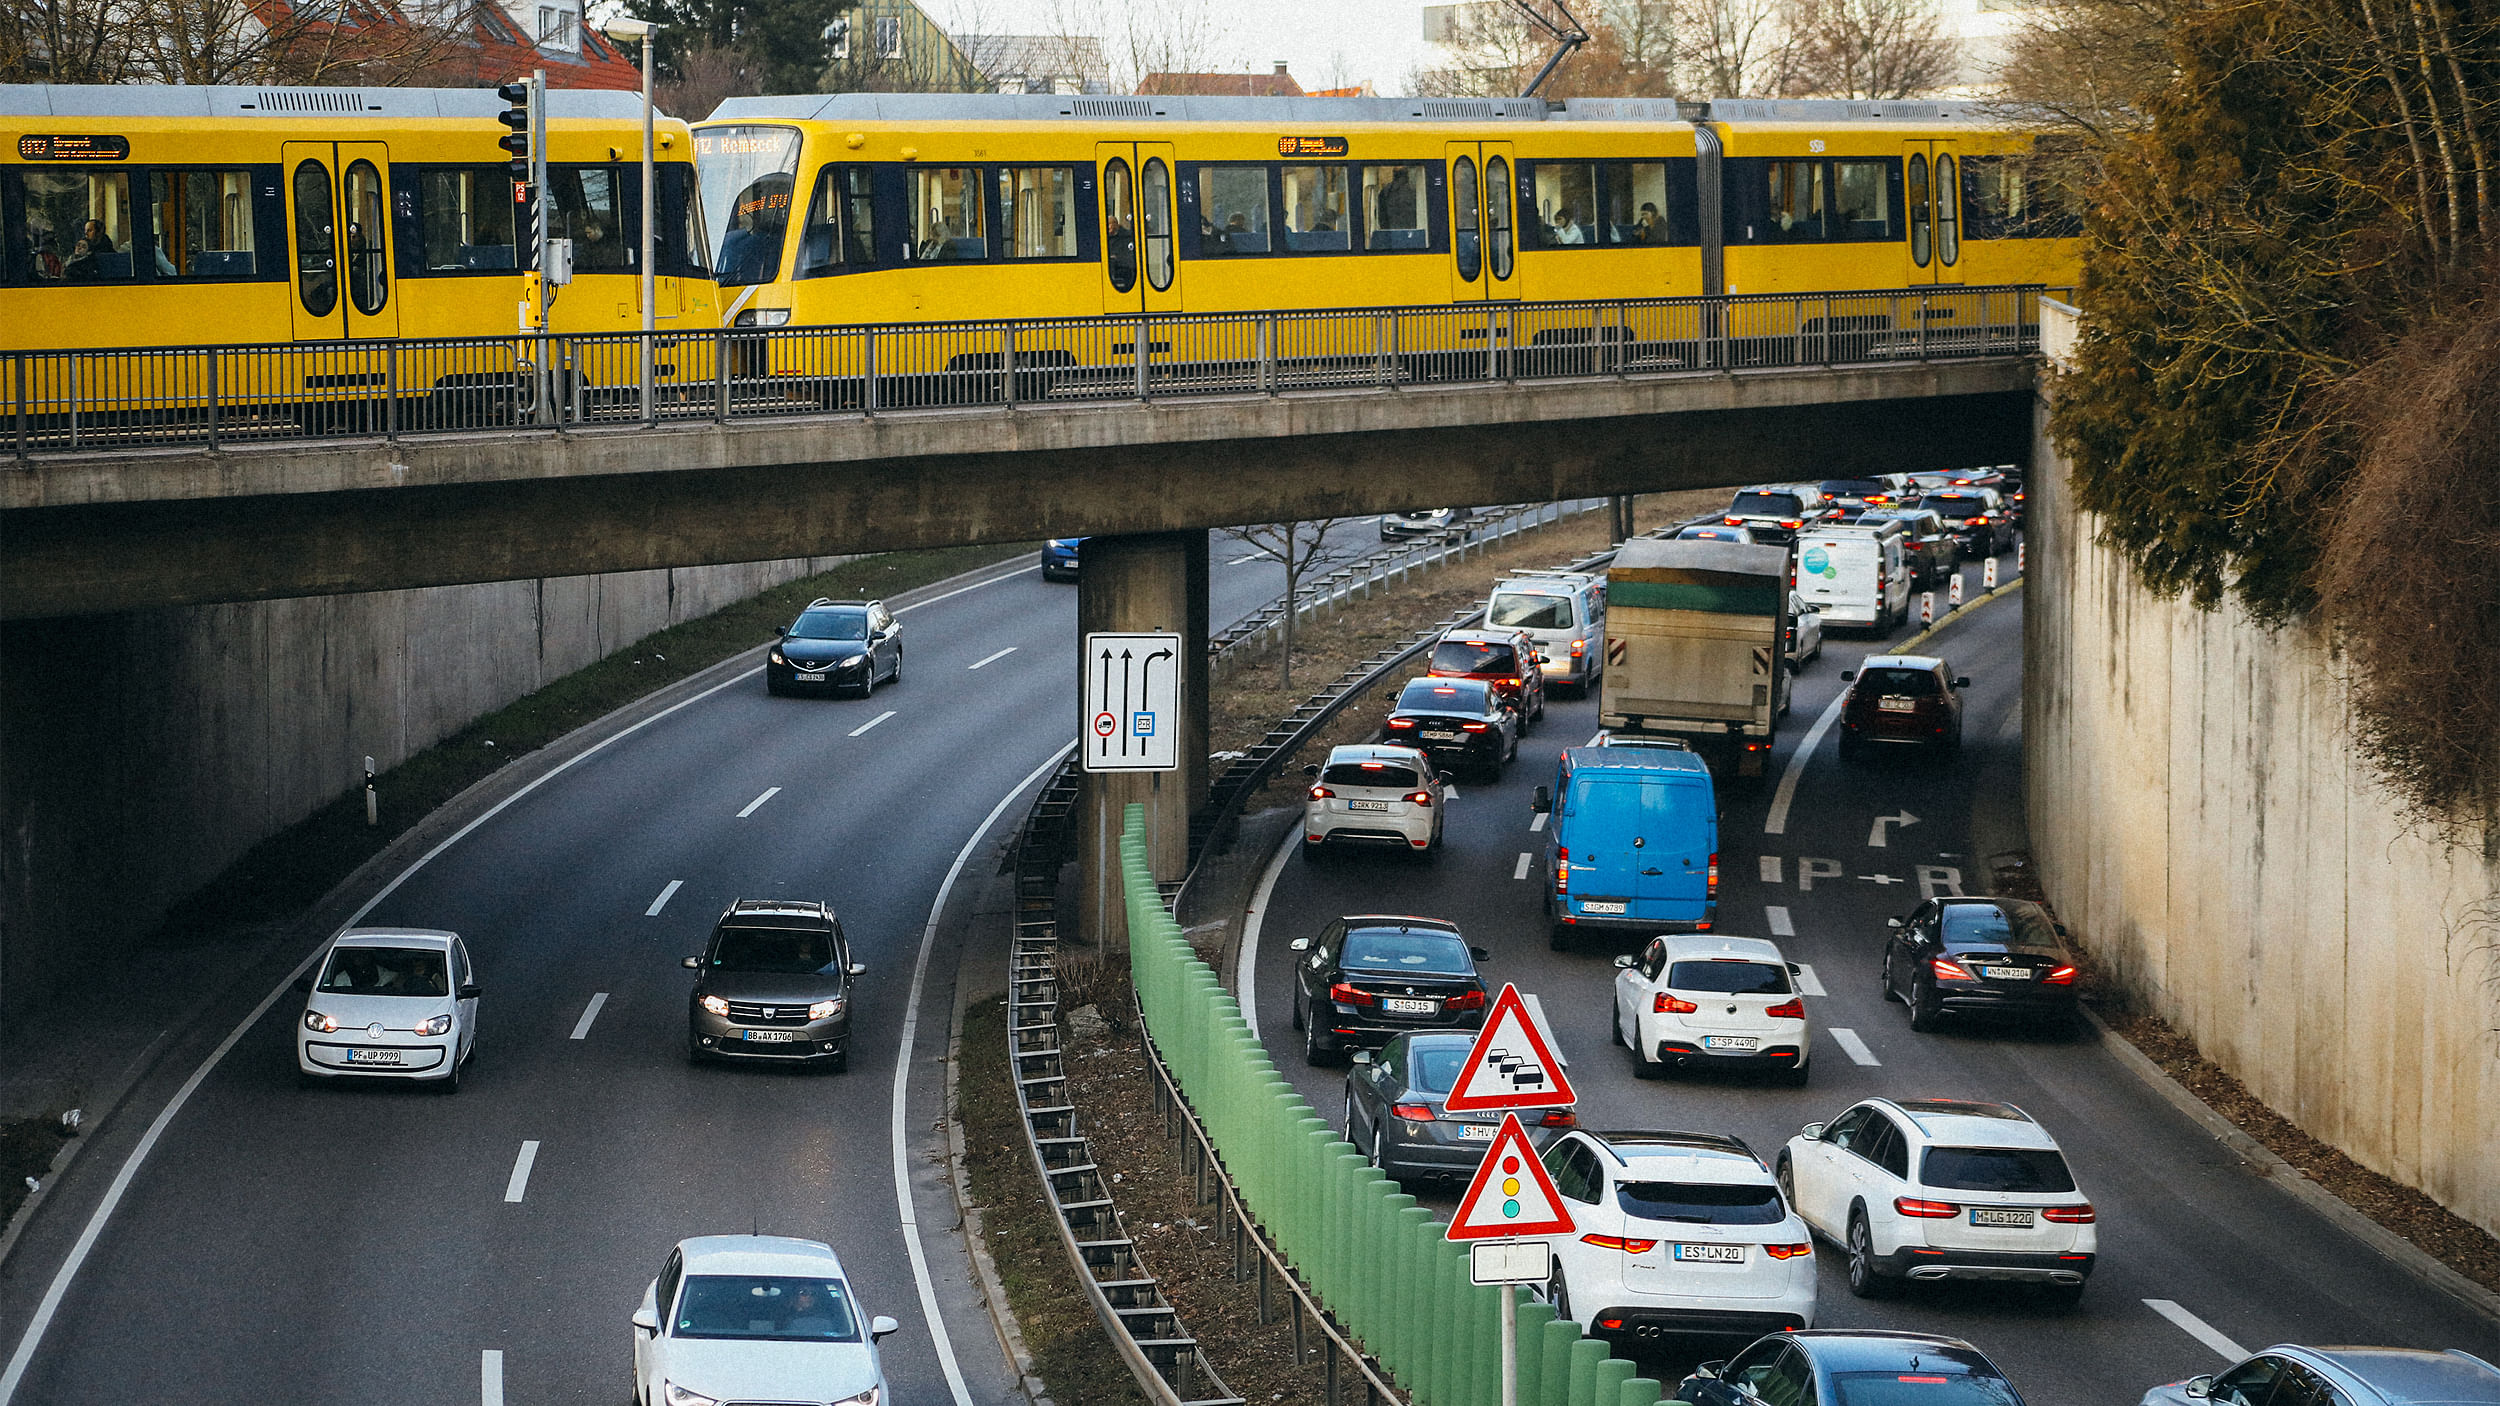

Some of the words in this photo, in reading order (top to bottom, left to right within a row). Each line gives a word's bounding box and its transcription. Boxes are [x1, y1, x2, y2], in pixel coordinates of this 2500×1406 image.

[516, 184, 525, 193] PS
[517, 192, 524, 201] 12
[1393, 1000, 1400, 1009] S
[748, 1031, 758, 1040] BB
[1710, 1037, 1716, 1046] S
[1722, 1038, 1733, 1047] SP
[353, 1050, 363, 1059] PF
[1464, 1126, 1471, 1137] S
[1976, 1211, 1984, 1222] M
[1990, 1211, 2004, 1223] LG
[2006, 1212, 2032, 1224] 1220
[1685, 1246, 1700, 1258] ES
[1707, 1247, 1722, 1259] LN
[1724, 1248, 1739, 1260] 20
